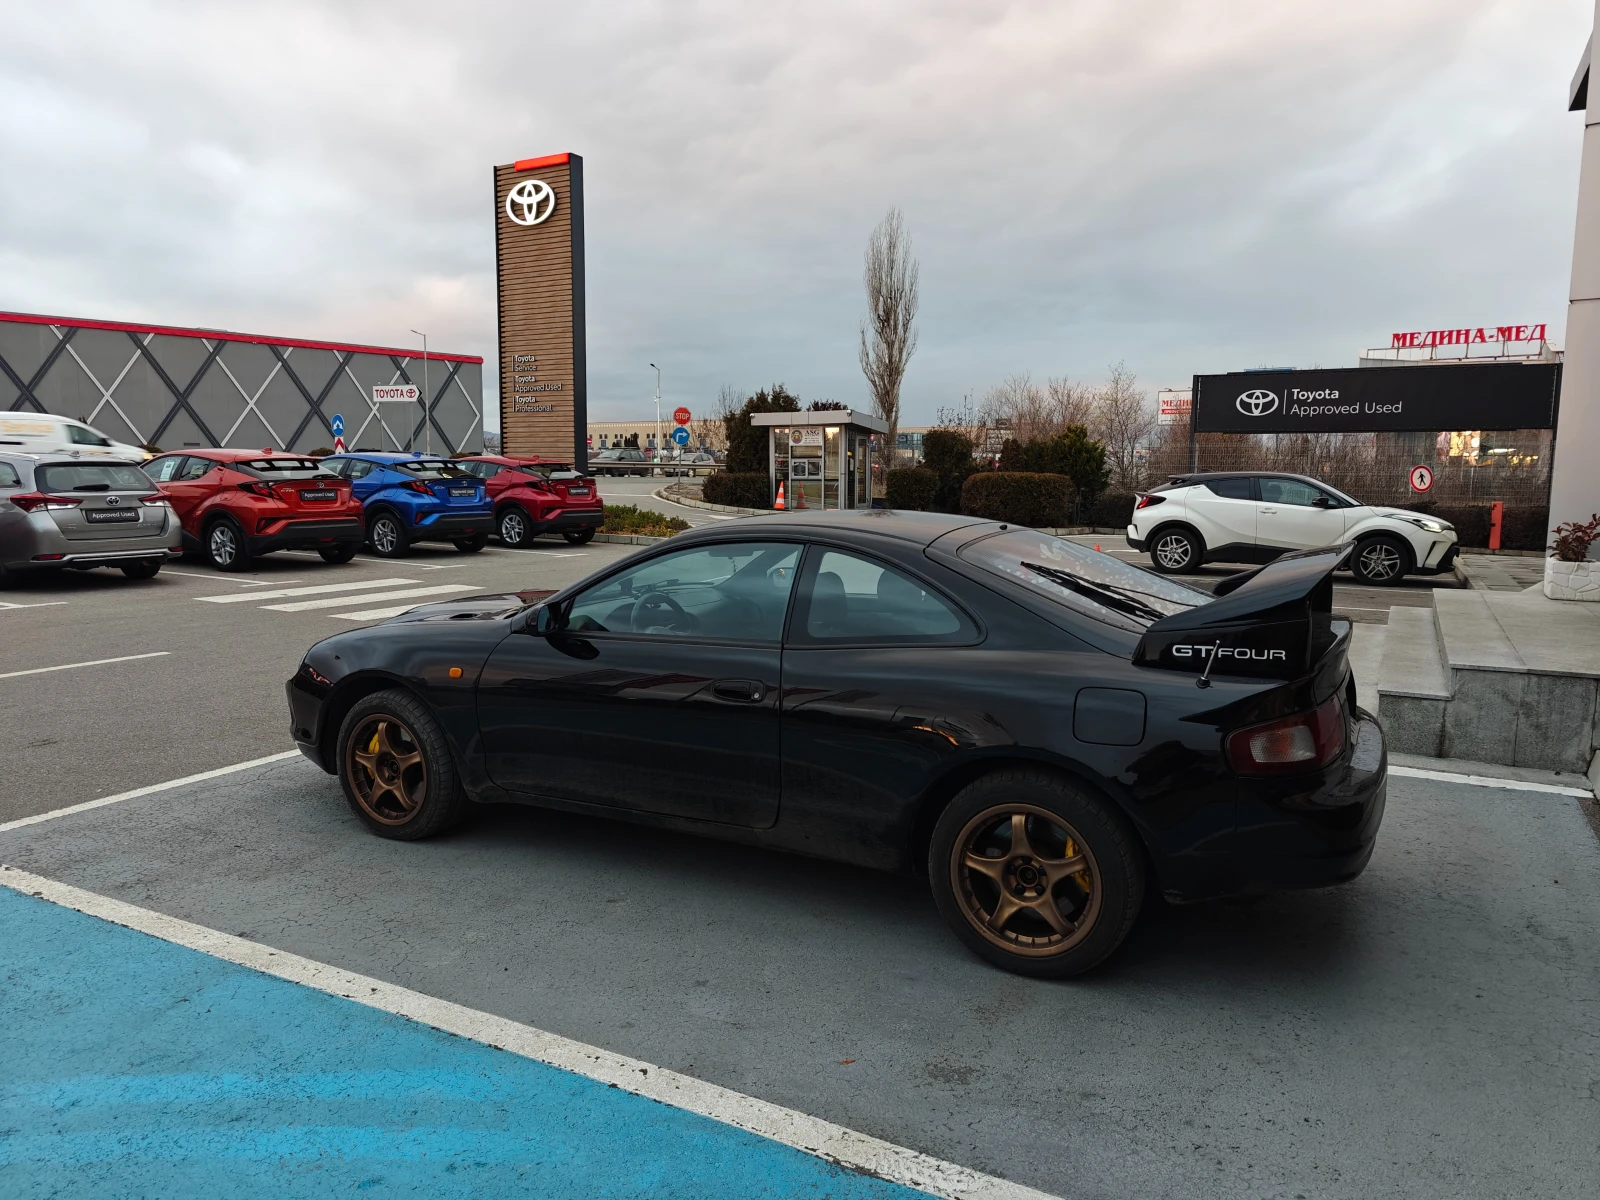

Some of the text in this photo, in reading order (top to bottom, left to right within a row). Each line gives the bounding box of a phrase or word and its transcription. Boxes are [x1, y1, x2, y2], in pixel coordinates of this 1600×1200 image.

[1391, 323, 1547, 350] МЕДИНА-МЕД
[514, 355, 535, 363] Toyota
[514, 375, 536, 384] Toyota
[515, 383, 562, 393] Approved Used
[374, 388, 405, 399] TOYOTA
[1291, 388, 1340, 403] Toyota
[515, 395, 536, 404] Toyota
[1161, 399, 1192, 407] МЕДИ
[515, 404, 553, 412] Professional
[1290, 400, 1403, 418] Approved Used
[675, 412, 690, 420] STOP
[92, 511, 120, 519] Approved
